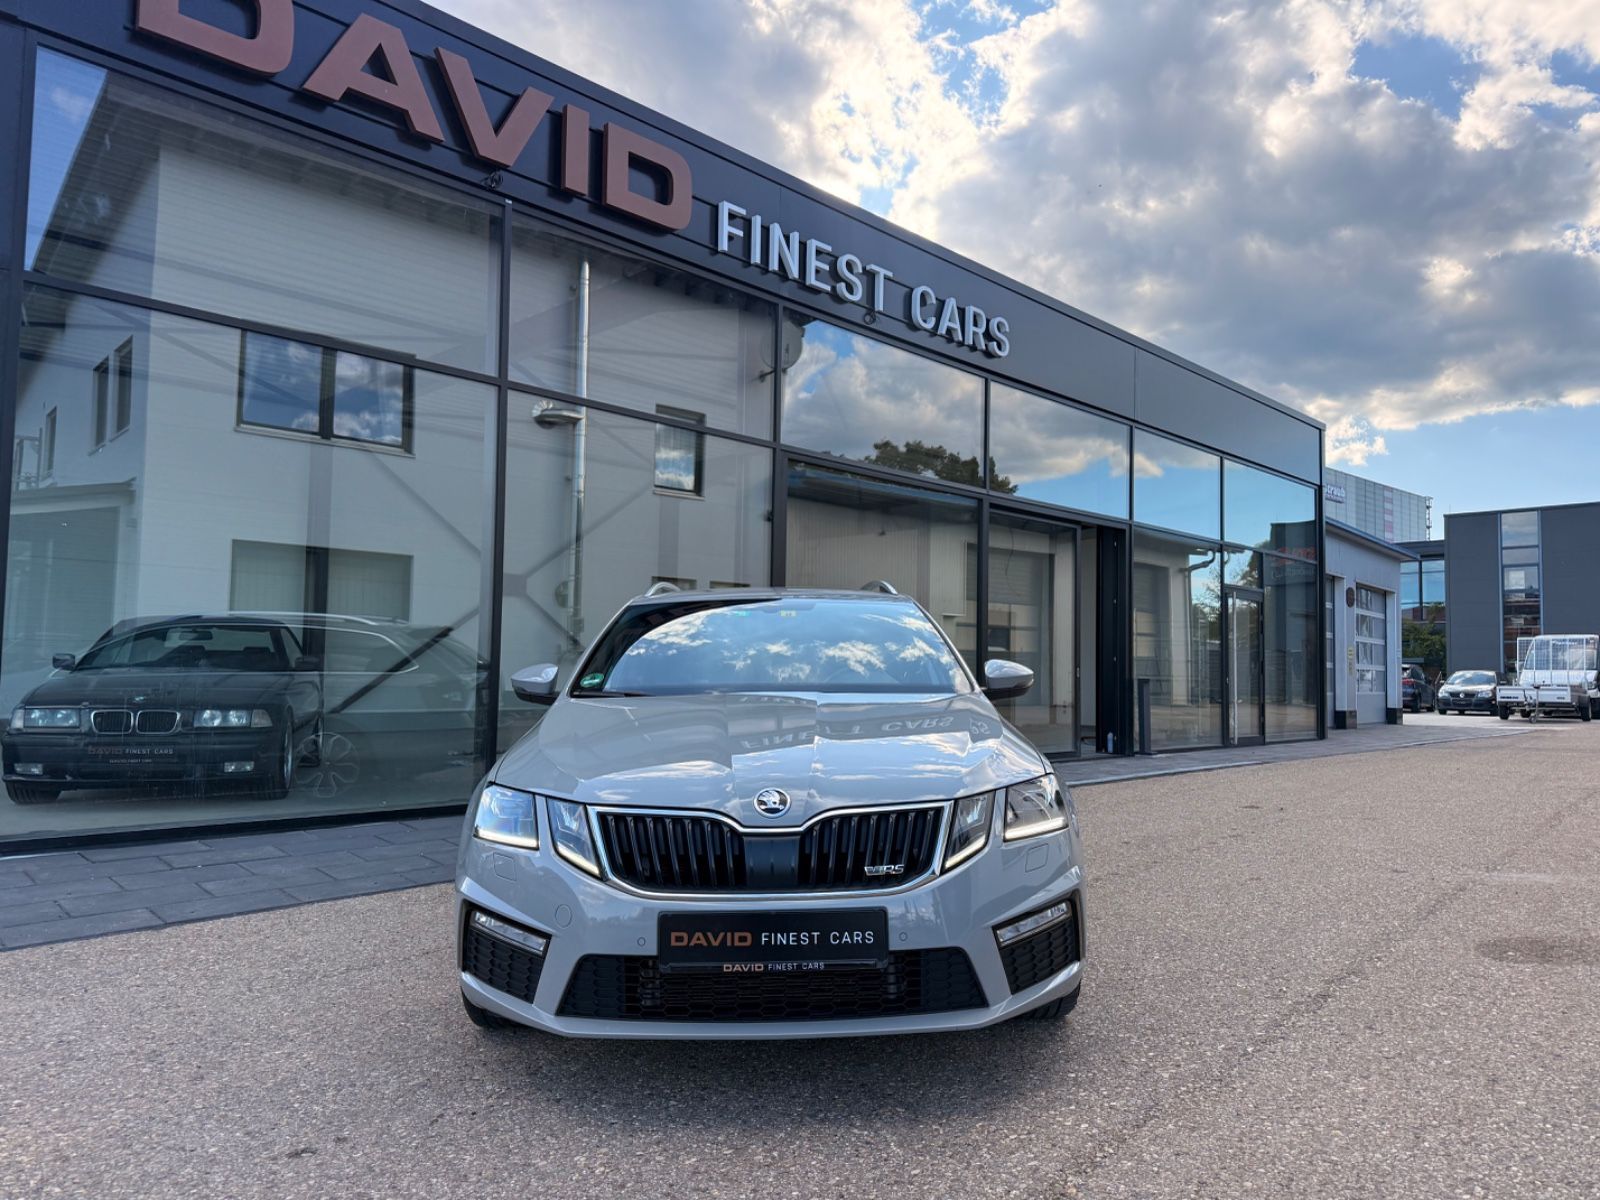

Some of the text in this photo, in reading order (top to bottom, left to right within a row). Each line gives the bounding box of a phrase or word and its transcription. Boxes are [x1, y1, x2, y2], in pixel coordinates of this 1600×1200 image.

[135, 0, 692, 232] DAVID
[717, 200, 1010, 358] FINEST CARS
[125, 747, 151, 755] FINEST
[670, 931, 875, 947] DAVID FINEST CARS
[723, 961, 826, 973] DAVID FINEST CARS
